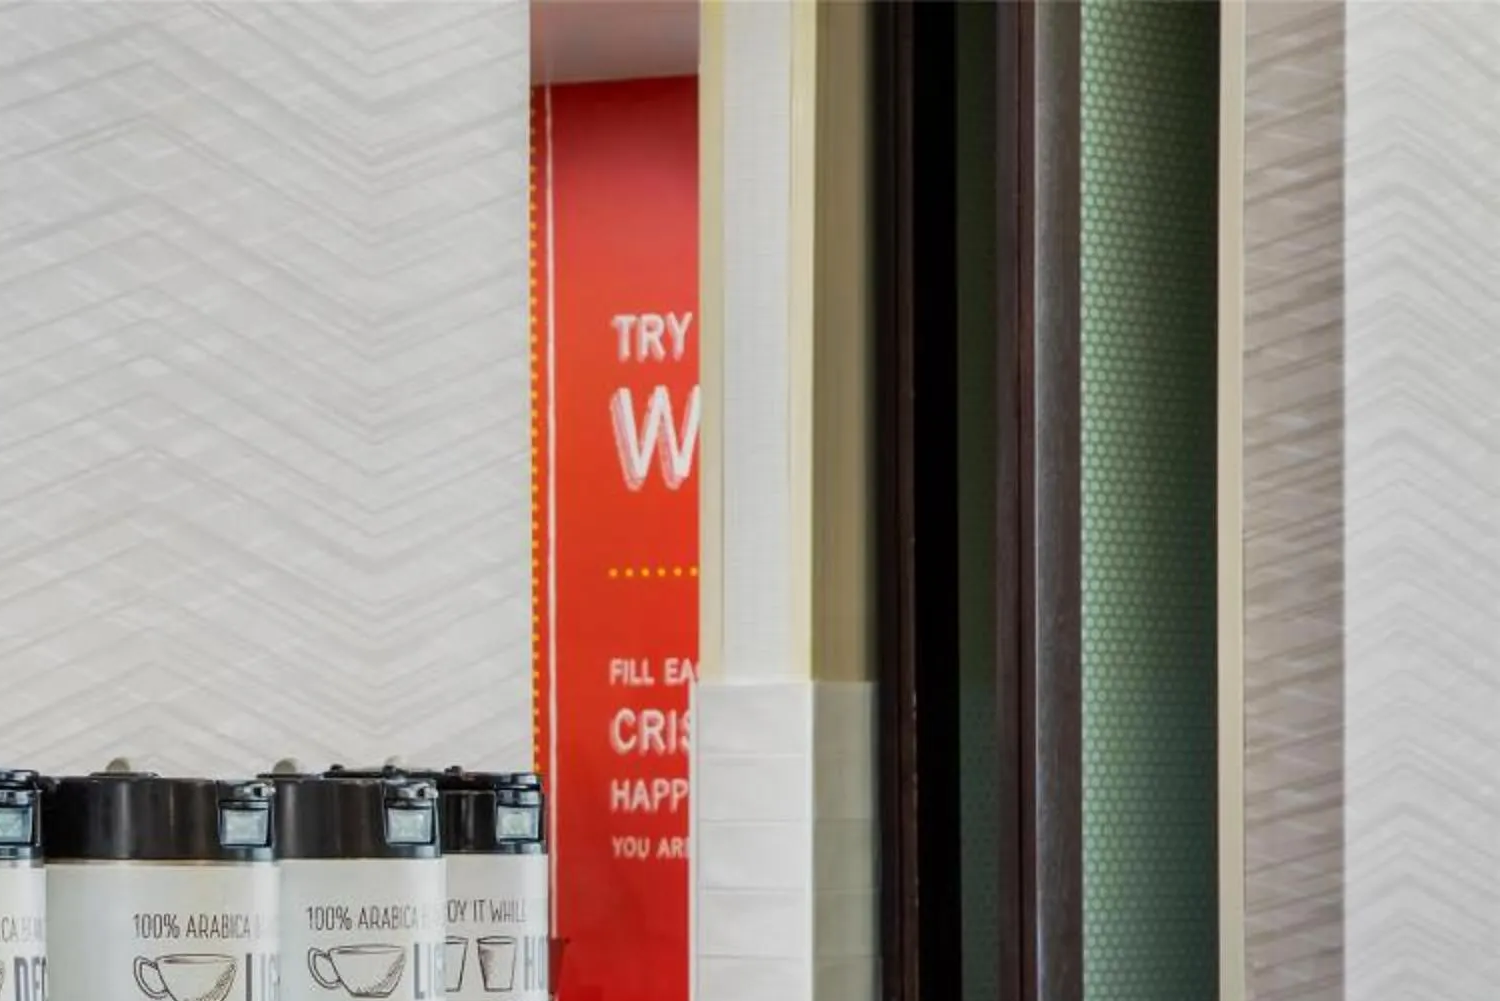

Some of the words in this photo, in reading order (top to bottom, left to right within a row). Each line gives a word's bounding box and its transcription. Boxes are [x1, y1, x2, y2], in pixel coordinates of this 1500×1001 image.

[611, 311, 693, 363] TRY
[610, 658, 654, 685] FILL
[664, 657, 699, 685] EA
[611, 778, 689, 813] HAPP
[612, 836, 651, 860] YOU
[306, 905, 352, 931] 100%
[357, 905, 418, 931] ARABICA
[473, 899, 485, 923] IT
[133, 912, 180, 940] 100%
[185, 912, 251, 940] ARABICA
